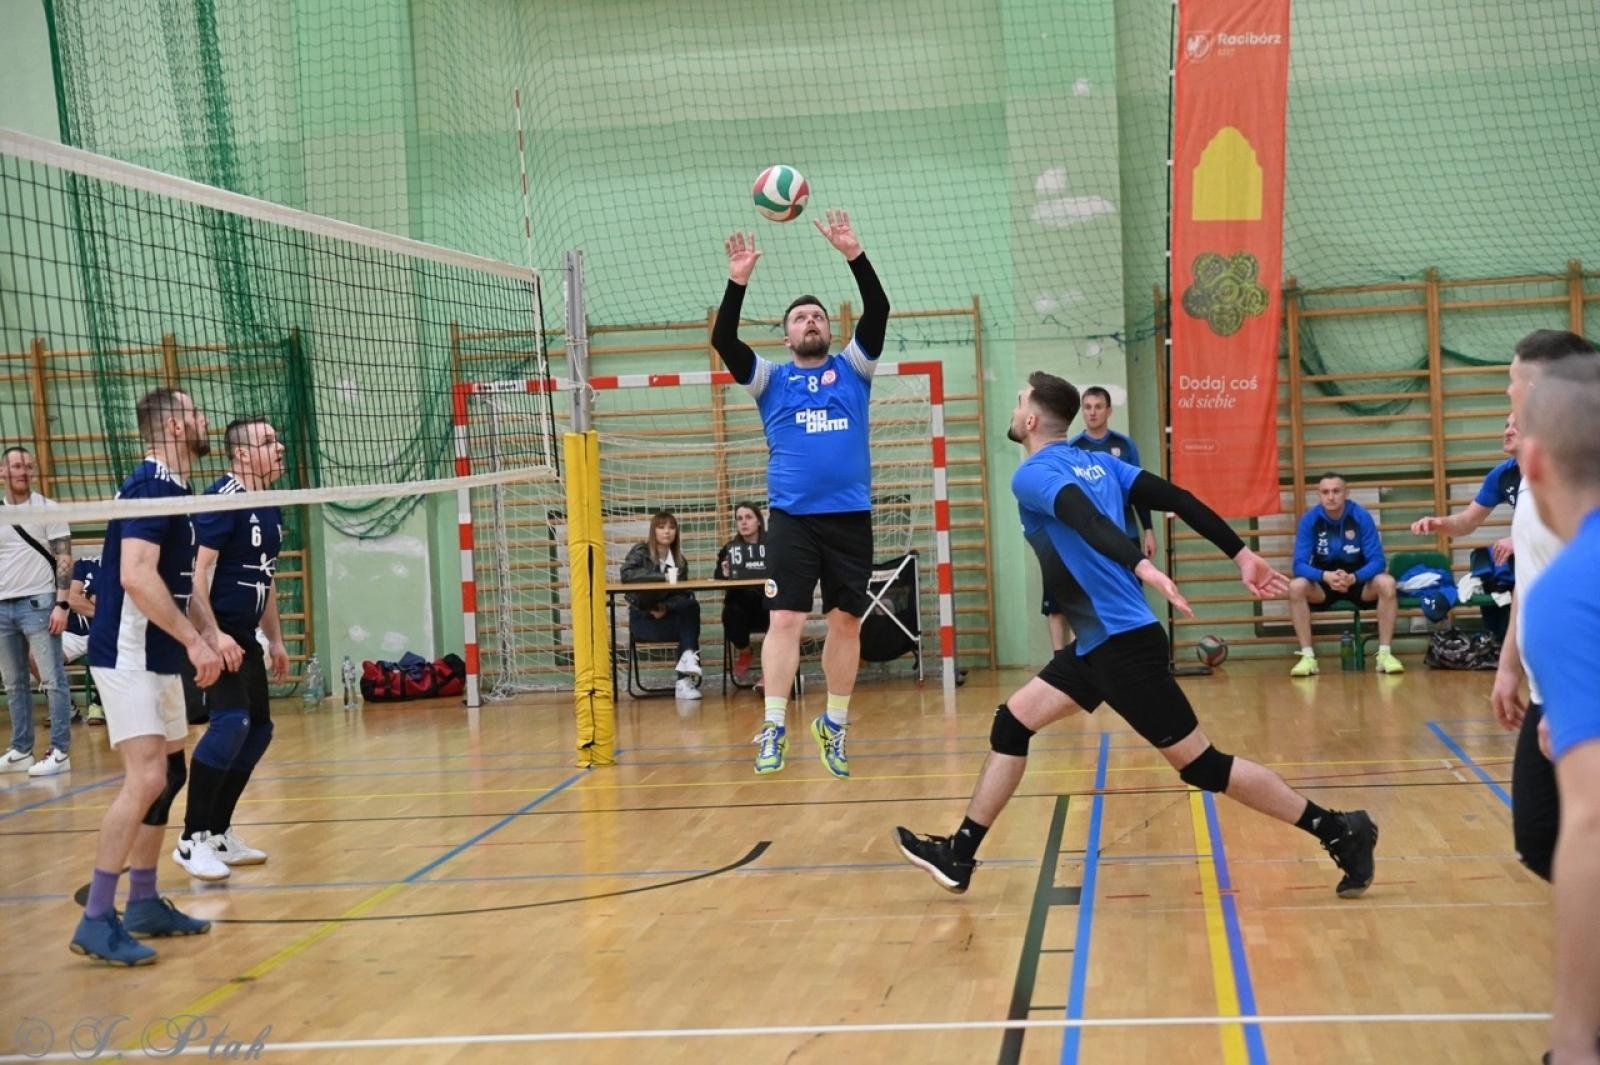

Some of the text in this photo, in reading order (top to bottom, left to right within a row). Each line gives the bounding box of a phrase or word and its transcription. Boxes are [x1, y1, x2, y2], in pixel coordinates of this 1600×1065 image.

[1217, 32, 1281, 45] Racibórz
[807, 375, 819, 393] 8
[1179, 375, 1258, 394] Dodaj coś
[1178, 395, 1236, 408] od siebie
[251, 525, 262, 547] 6
[728, 545, 766, 564] 15 1 0
